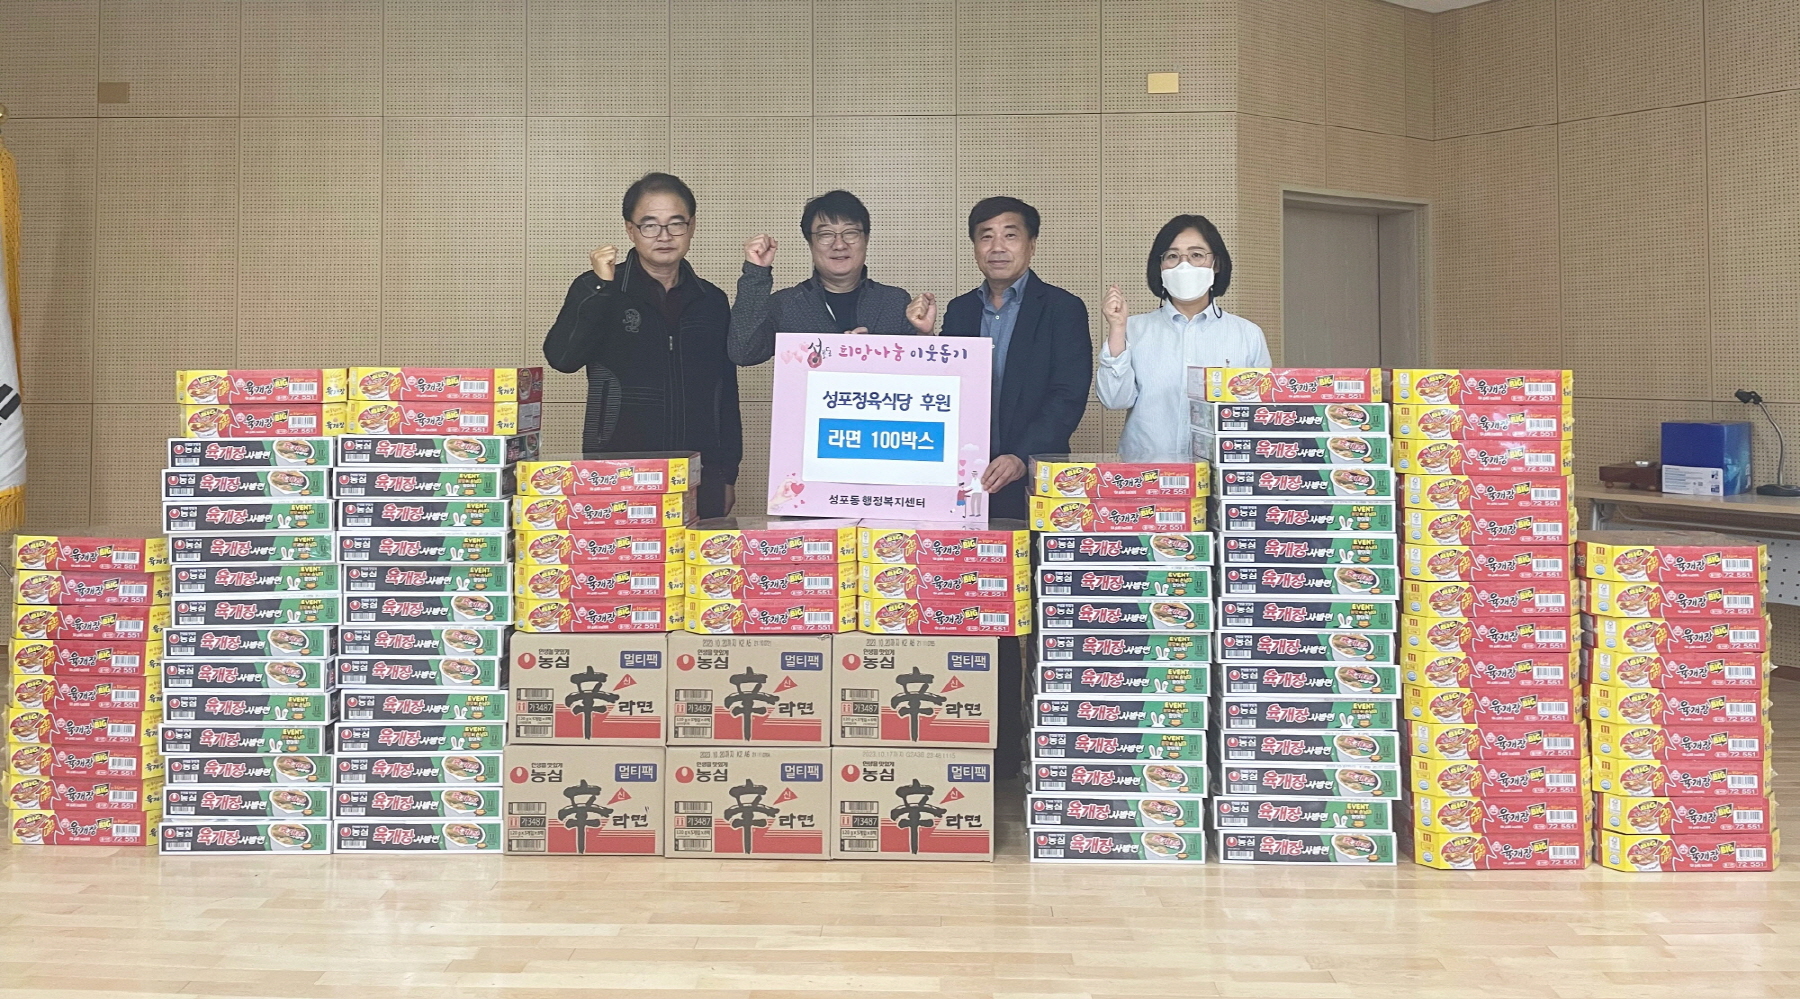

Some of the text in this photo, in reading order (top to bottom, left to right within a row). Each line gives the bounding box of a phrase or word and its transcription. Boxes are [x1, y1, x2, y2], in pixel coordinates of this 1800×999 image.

[838, 343, 968, 363] 희망나눔 이웃돕기
[1288, 376, 1332, 393] 육개장 BIG
[823, 390, 951, 411] 성포정육식당 후원
[416, 411, 458, 427] 육개장 BIG
[1254, 408, 1296, 426] 육개장
[828, 430, 934, 450] 라면 100박스
[205, 444, 245, 461] 육개장
[376, 440, 441, 457] 육개장 사발면
[829, 494, 926, 508] 성포동 행정복지센터
[1487, 485, 1530, 501] 육개장 BIG
[584, 503, 627, 518] 육개장 BIG
[1111, 508, 1154, 524] 육개장 BIG
[211, 539, 276, 556] 육개장 사발면
[380, 538, 445, 556] 육개장 사발면
[1058, 540, 1075, 548] 농심
[1080, 538, 1147, 556] 육개장 사발면
[760, 609, 803, 625] 육개장 BIG
[934, 609, 978, 625] 육개장 BIG
[1258, 636, 1326, 654] 육개장 사발면
[69, 651, 111, 667] 육개장 BIG
[539, 656, 569, 668] 농심
[624, 654, 658, 666] 멀티팩
[697, 657, 728, 669] 농심
[785, 655, 819, 667] 멀티팩
[863, 656, 895, 669] 농심
[952, 655, 986, 667] 멀티팩
[198, 665, 238, 682] 육개장
[372, 662, 437, 679] 육개장 사발면
[529, 703, 552, 711] 가3487
[565, 666, 620, 739] 辛
[619, 700, 654, 715] 라면
[688, 704, 711, 712] 가3487
[724, 666, 779, 741] 辛
[779, 701, 814, 717] 라면
[854, 704, 877, 712] 가3487
[891, 666, 947, 742] 辛
[946, 702, 982, 718] 라면
[1052, 704, 1068, 712] 농심
[1353, 702, 1374, 710] EVENT
[1078, 703, 1147, 720] 육개장 사발면
[1267, 705, 1334, 723] 육개장 사발면
[531, 769, 562, 782] 농심
[619, 766, 653, 779] 멀티팩
[696, 769, 727, 782] 농심
[785, 766, 819, 779] 멀티팩
[863, 768, 894, 781] 농심
[952, 766, 986, 780] 멀티팩
[1499, 770, 1543, 786] 육개장 BIG
[1681, 771, 1725, 787] 육개장 BIG
[784, 791, 791, 799] 신
[950, 791, 958, 799] 신
[521, 818, 544, 826] 가3487
[558, 779, 614, 854] 辛
[613, 814, 648, 828] 라면
[724, 779, 779, 854] 辛
[779, 813, 815, 828] 라면
[854, 818, 877, 826] 가3487
[891, 779, 947, 854] 辛
[946, 814, 982, 829] 라면
[374, 827, 440, 845] 육개장 사발면
[1070, 835, 1138, 853] 육개장 사발면
[1260, 837, 1329, 855] 육개장 사발면
[1689, 845, 1733, 861] 육개장 BIG
